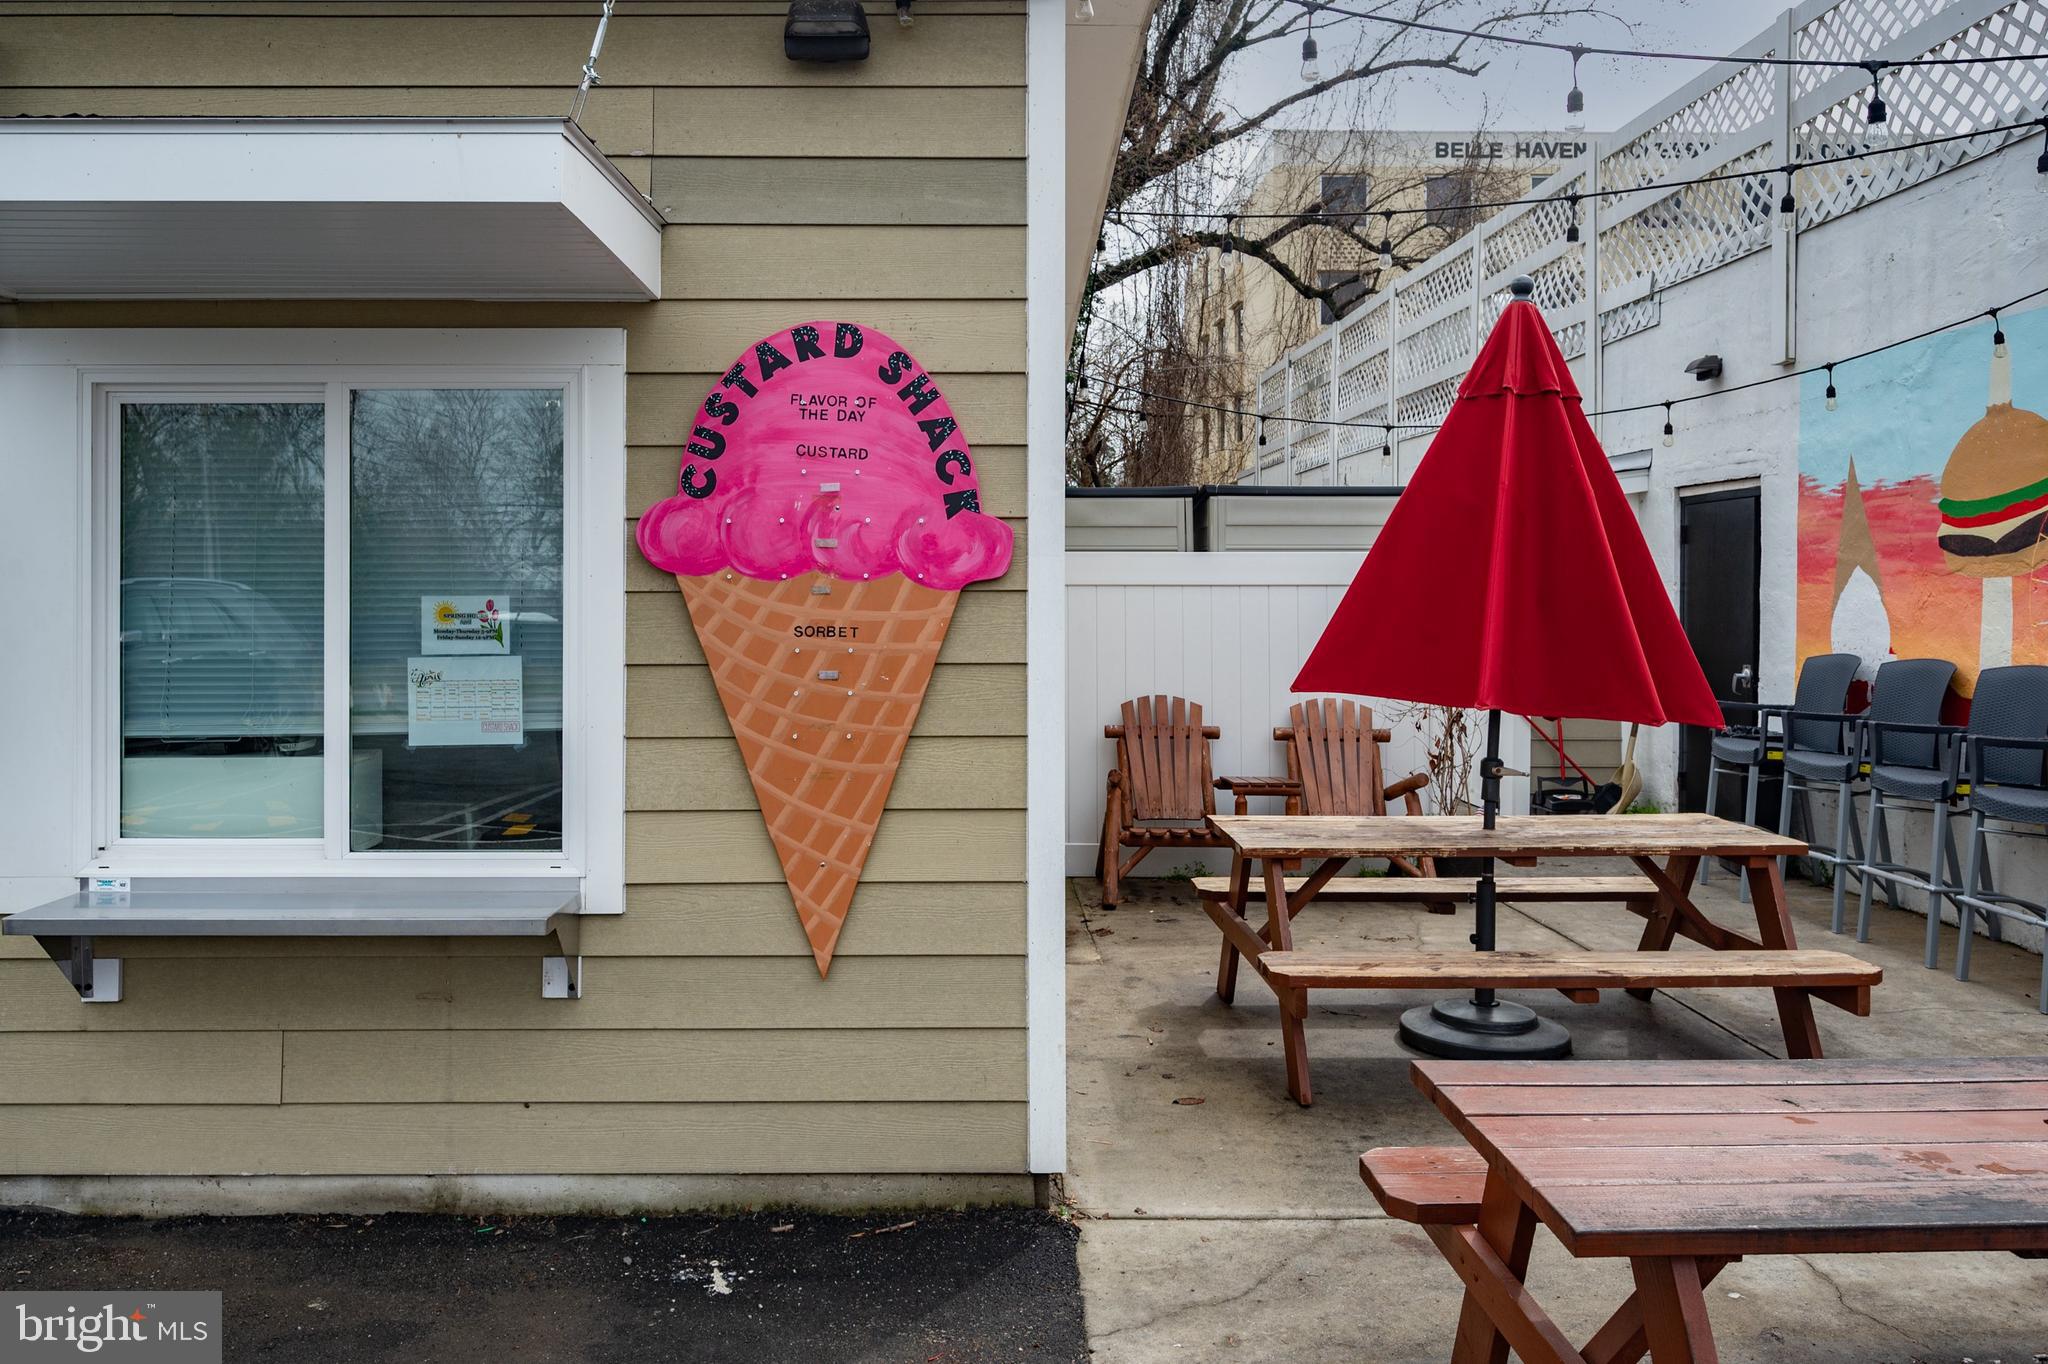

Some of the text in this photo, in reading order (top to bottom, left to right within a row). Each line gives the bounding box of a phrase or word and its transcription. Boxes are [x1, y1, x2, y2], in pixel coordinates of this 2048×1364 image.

[1435, 141, 1587, 159] BELLE HAVEN
[790, 393, 877, 409] FLAVOR OF
[681, 323, 980, 520] CUSTARD SHACK
[799, 408, 866, 422] THE DAY
[796, 444, 869, 460] CUSTARD
[794, 625, 859, 638] SORBET
